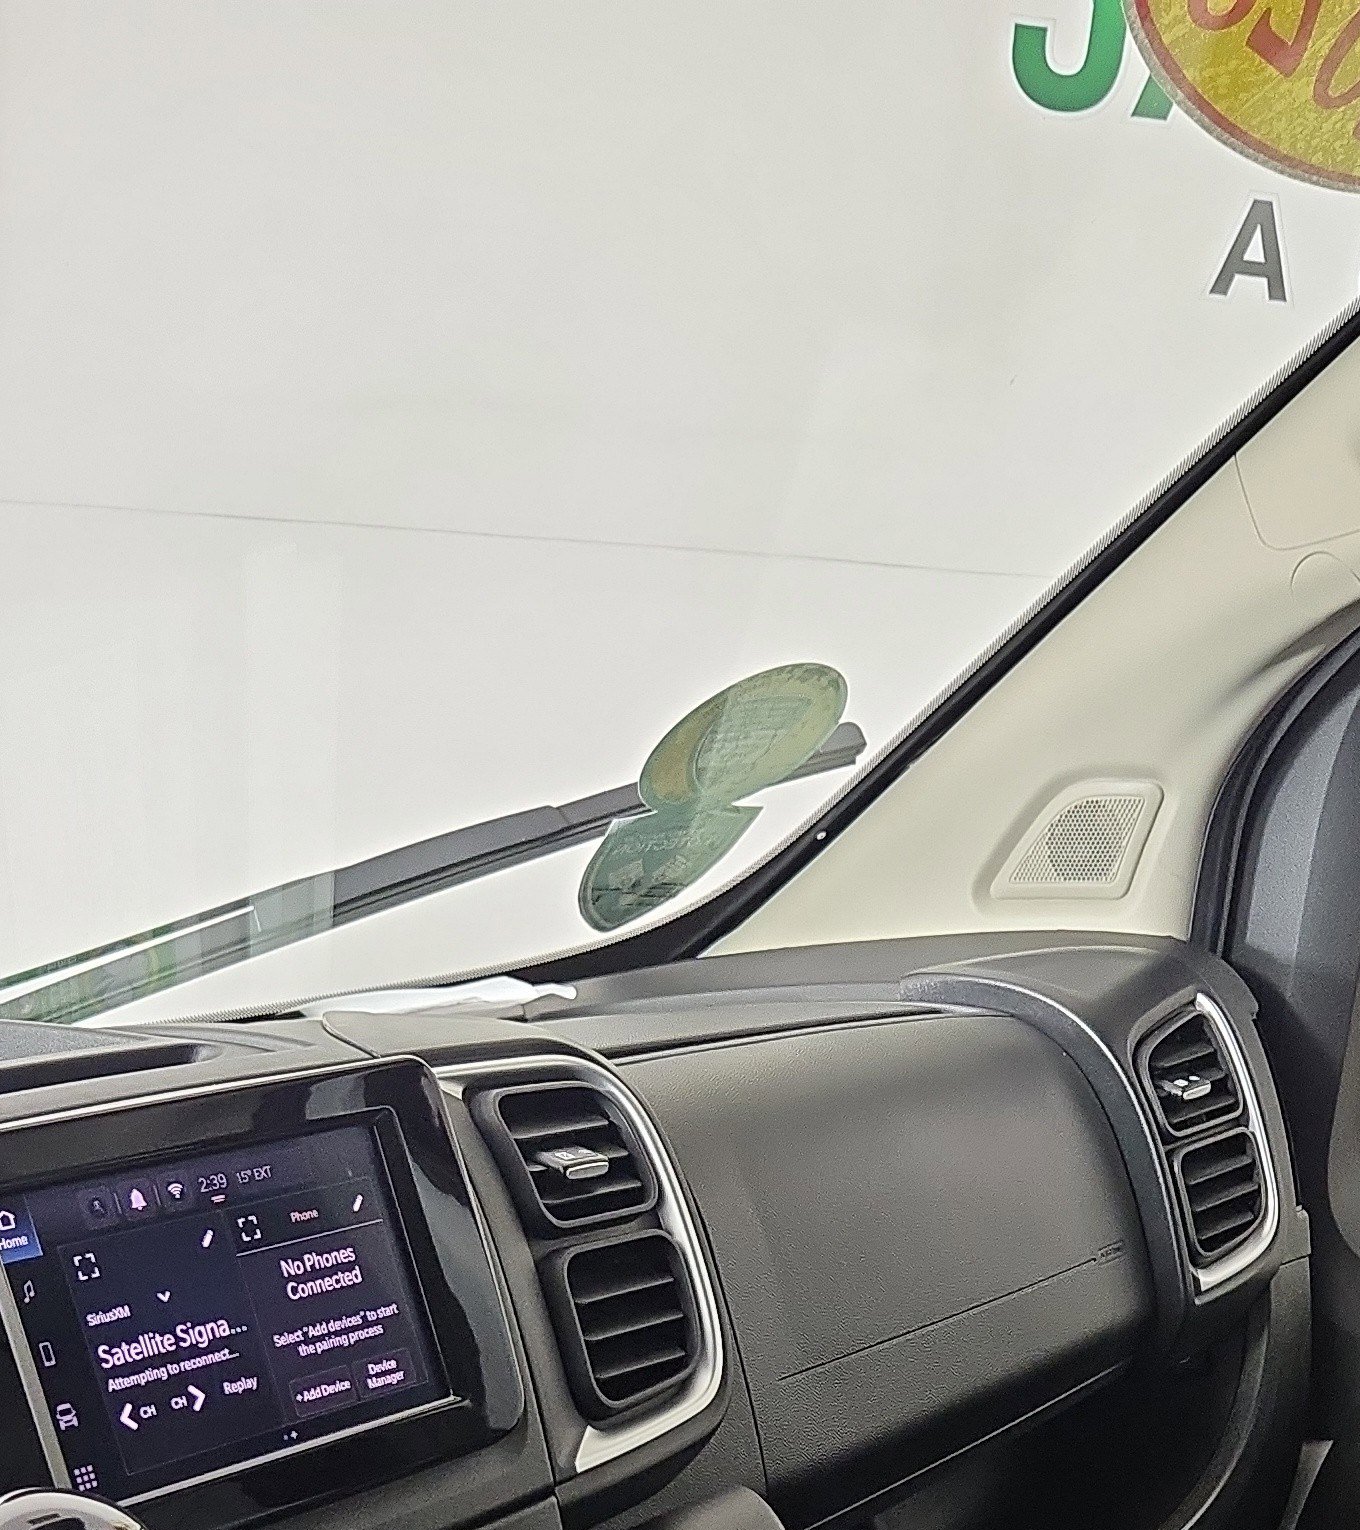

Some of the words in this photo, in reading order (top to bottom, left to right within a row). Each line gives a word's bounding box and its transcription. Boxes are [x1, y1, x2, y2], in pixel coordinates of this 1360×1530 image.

[198, 1173, 227, 1192] 2:39
[253, 1165, 272, 1180] EXT
[290, 1209, 319, 1223] Phone
[280, 1258, 304, 1278] No
[303, 1247, 356, 1271] Phones
[286, 1265, 362, 1300] Connected
[86, 1305, 131, 1326] SiriusXM
[273, 1330, 305, 1347] Select
[366, 1310, 378, 1321] to
[378, 1303, 399, 1318] start
[97, 1332, 176, 1369] Satellite
[298, 1343, 316, 1356] the
[315, 1335, 349, 1354] pairing
[349, 1324, 384, 1344] process
[108, 1367, 168, 1392] Attempting
[167, 1363, 180, 1376] to
[367, 1359, 397, 1374] Device
[367, 1371, 405, 1389] Manager
[140, 1404, 157, 1418] CH
[171, 1396, 188, 1410] CH
[223, 1376, 258, 1395] Replay
[321, 1380, 351, 1397] Device
